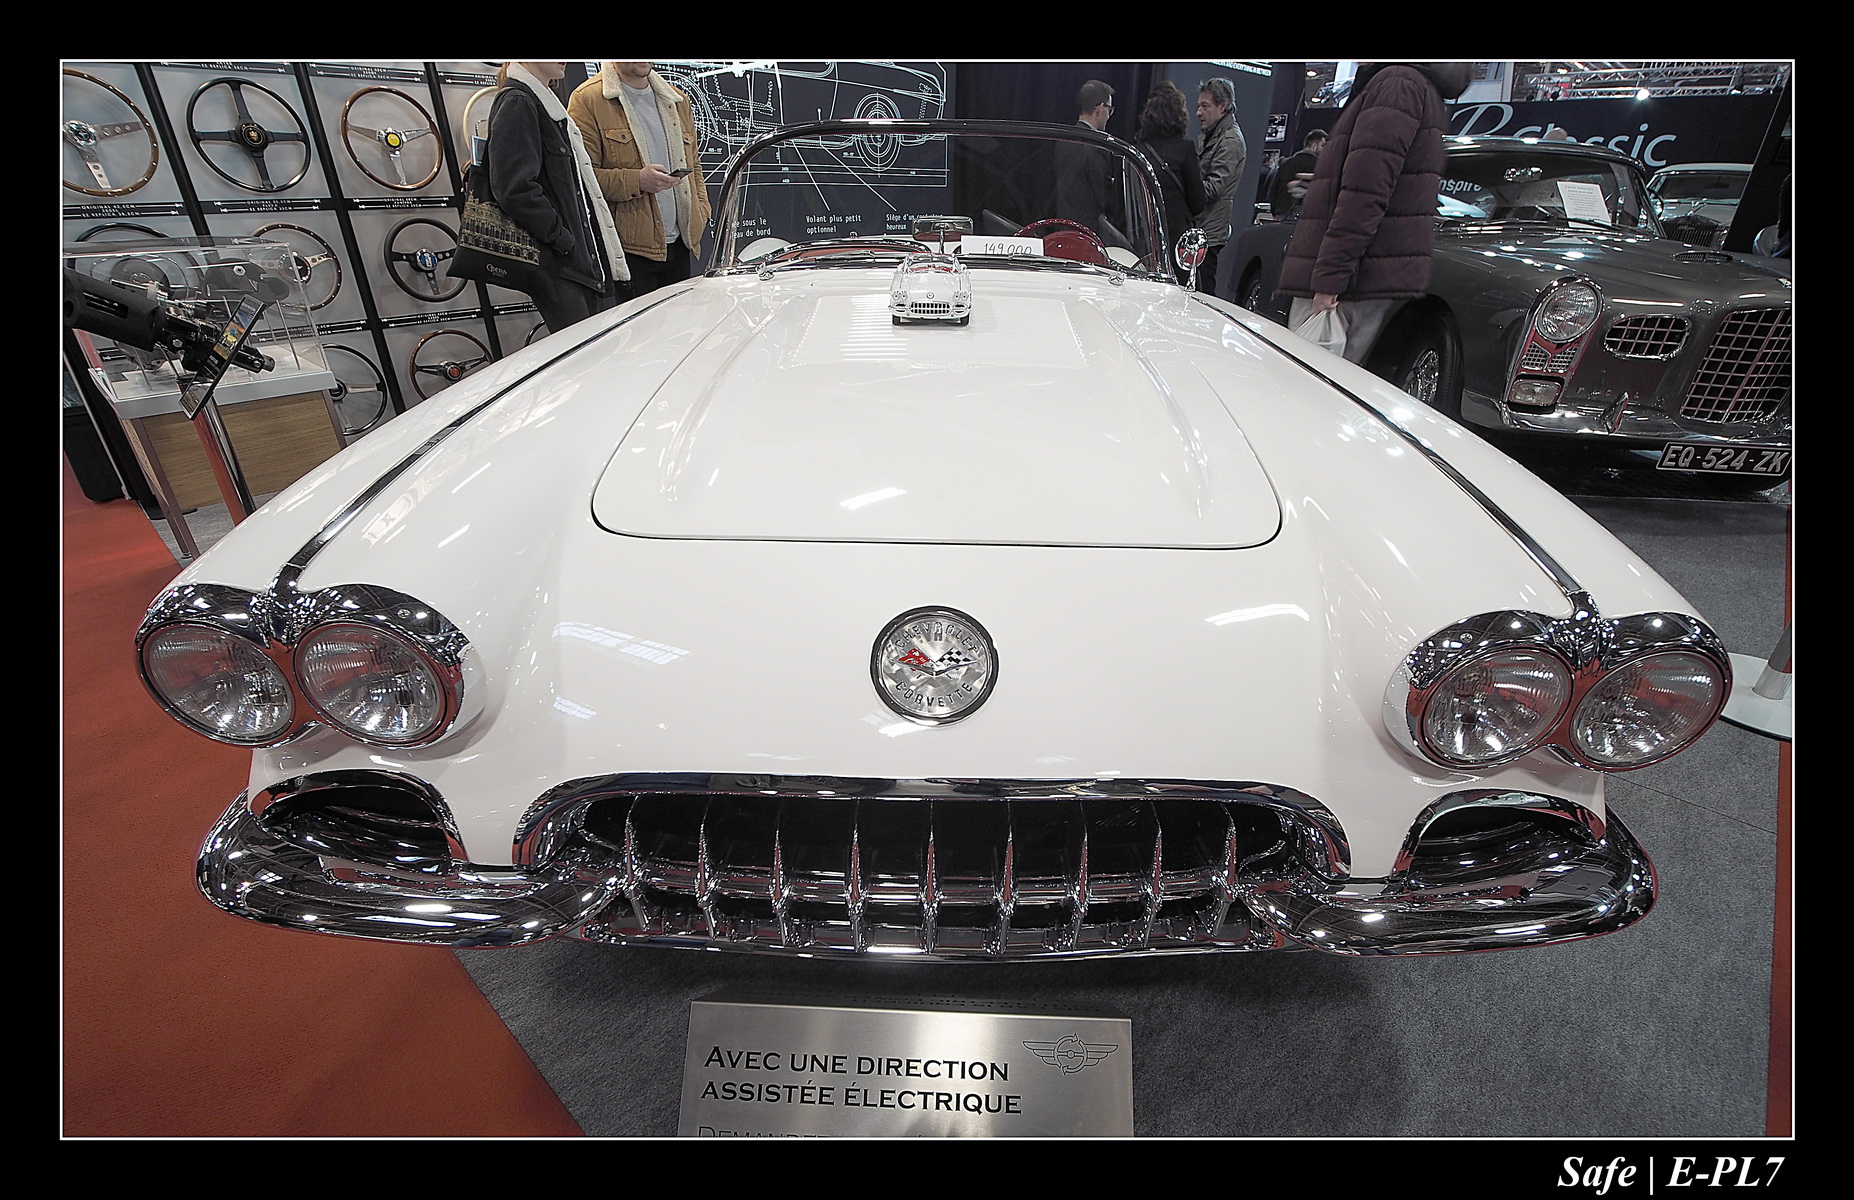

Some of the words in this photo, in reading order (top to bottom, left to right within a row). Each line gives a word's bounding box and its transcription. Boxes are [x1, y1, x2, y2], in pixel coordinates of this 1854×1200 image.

[1438, 177, 1482, 194] nspire
[742, 219, 756, 227] sous
[759, 216, 767, 226] le
[805, 215, 827, 223] Volant
[829, 214, 843, 224] plus
[845, 214, 862, 224] petit
[886, 213, 901, 222] Siège
[745, 229, 754, 237] de
[756, 227, 771, 237] bord
[806, 225, 837, 236] optionnel
[1661, 445, 1789, 472] EQ-524-ZK
[894, 621, 978, 653] CHEVROLET
[895, 681, 973, 708] CORVETTE
[703, 1046, 781, 1071] AVEC
[790, 1053, 848, 1074] UNE
[856, 1056, 1009, 1081] DIRECTION
[700, 1080, 835, 1106] ASSISTÉE
[843, 1081, 1022, 1115] ÉLECTRIQUE
